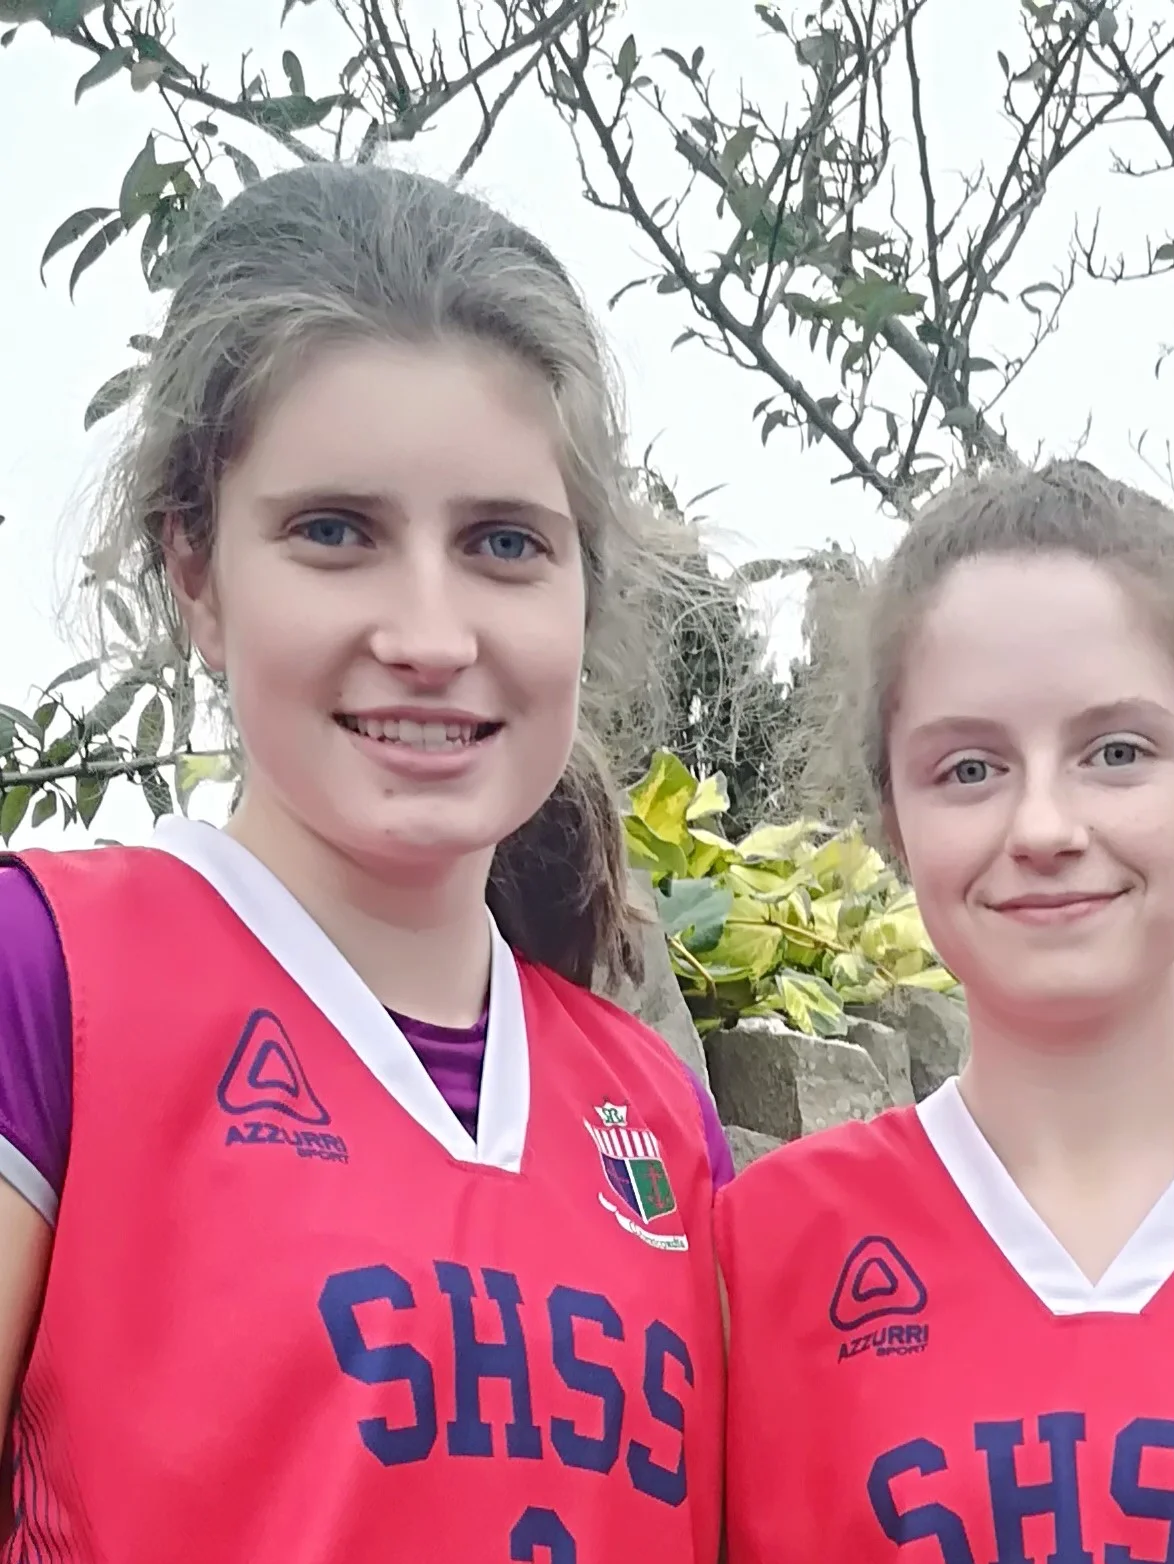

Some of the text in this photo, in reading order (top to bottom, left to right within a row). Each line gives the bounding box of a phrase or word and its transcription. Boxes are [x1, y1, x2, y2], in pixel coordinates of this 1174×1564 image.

[225, 1121, 348, 1153] AZZURRI
[837, 1323, 929, 1365] AZZURRI
[876, 1343, 926, 1357] SPORT
[317, 1259, 695, 1508] SHSS
